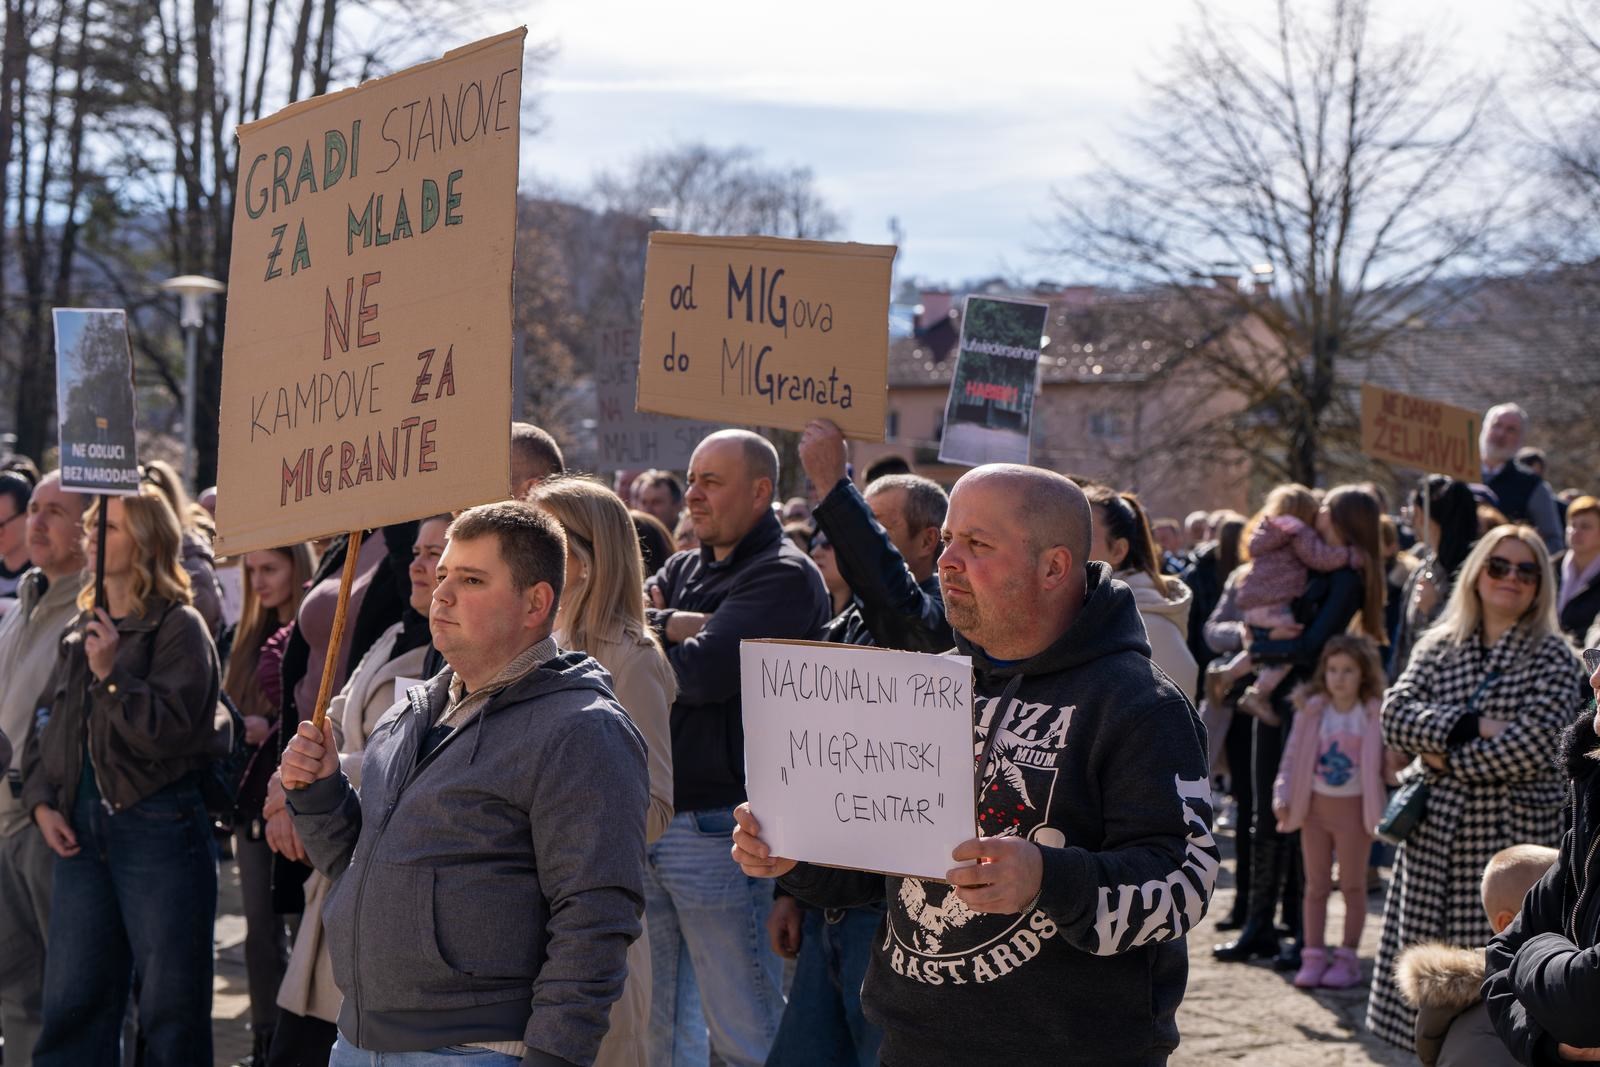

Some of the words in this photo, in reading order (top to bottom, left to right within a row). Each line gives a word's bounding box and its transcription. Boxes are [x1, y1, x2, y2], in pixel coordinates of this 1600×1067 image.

[245, 119, 362, 219] GRADI
[376, 68, 518, 174] STANOVE
[264, 217, 312, 281] ZA
[347, 169, 464, 256] MLADE
[323, 271, 382, 360] NE
[670, 264, 697, 310] od
[727, 263, 833, 339] MIGova
[251, 363, 385, 443] KAMPOVE
[411, 344, 456, 403] ZA
[663, 331, 689, 372] do
[721, 338, 853, 409] MIGranata
[62, 465, 83, 480] BEZ
[71, 443, 87, 458] NE
[280, 416, 438, 507] MIGRANTE
[761, 658, 898, 704] NACIONALNI
[906, 673, 964, 711] PARK
[1012, 747, 1058, 767] MIUM
[890, 908, 1058, 986] BASTARDS
